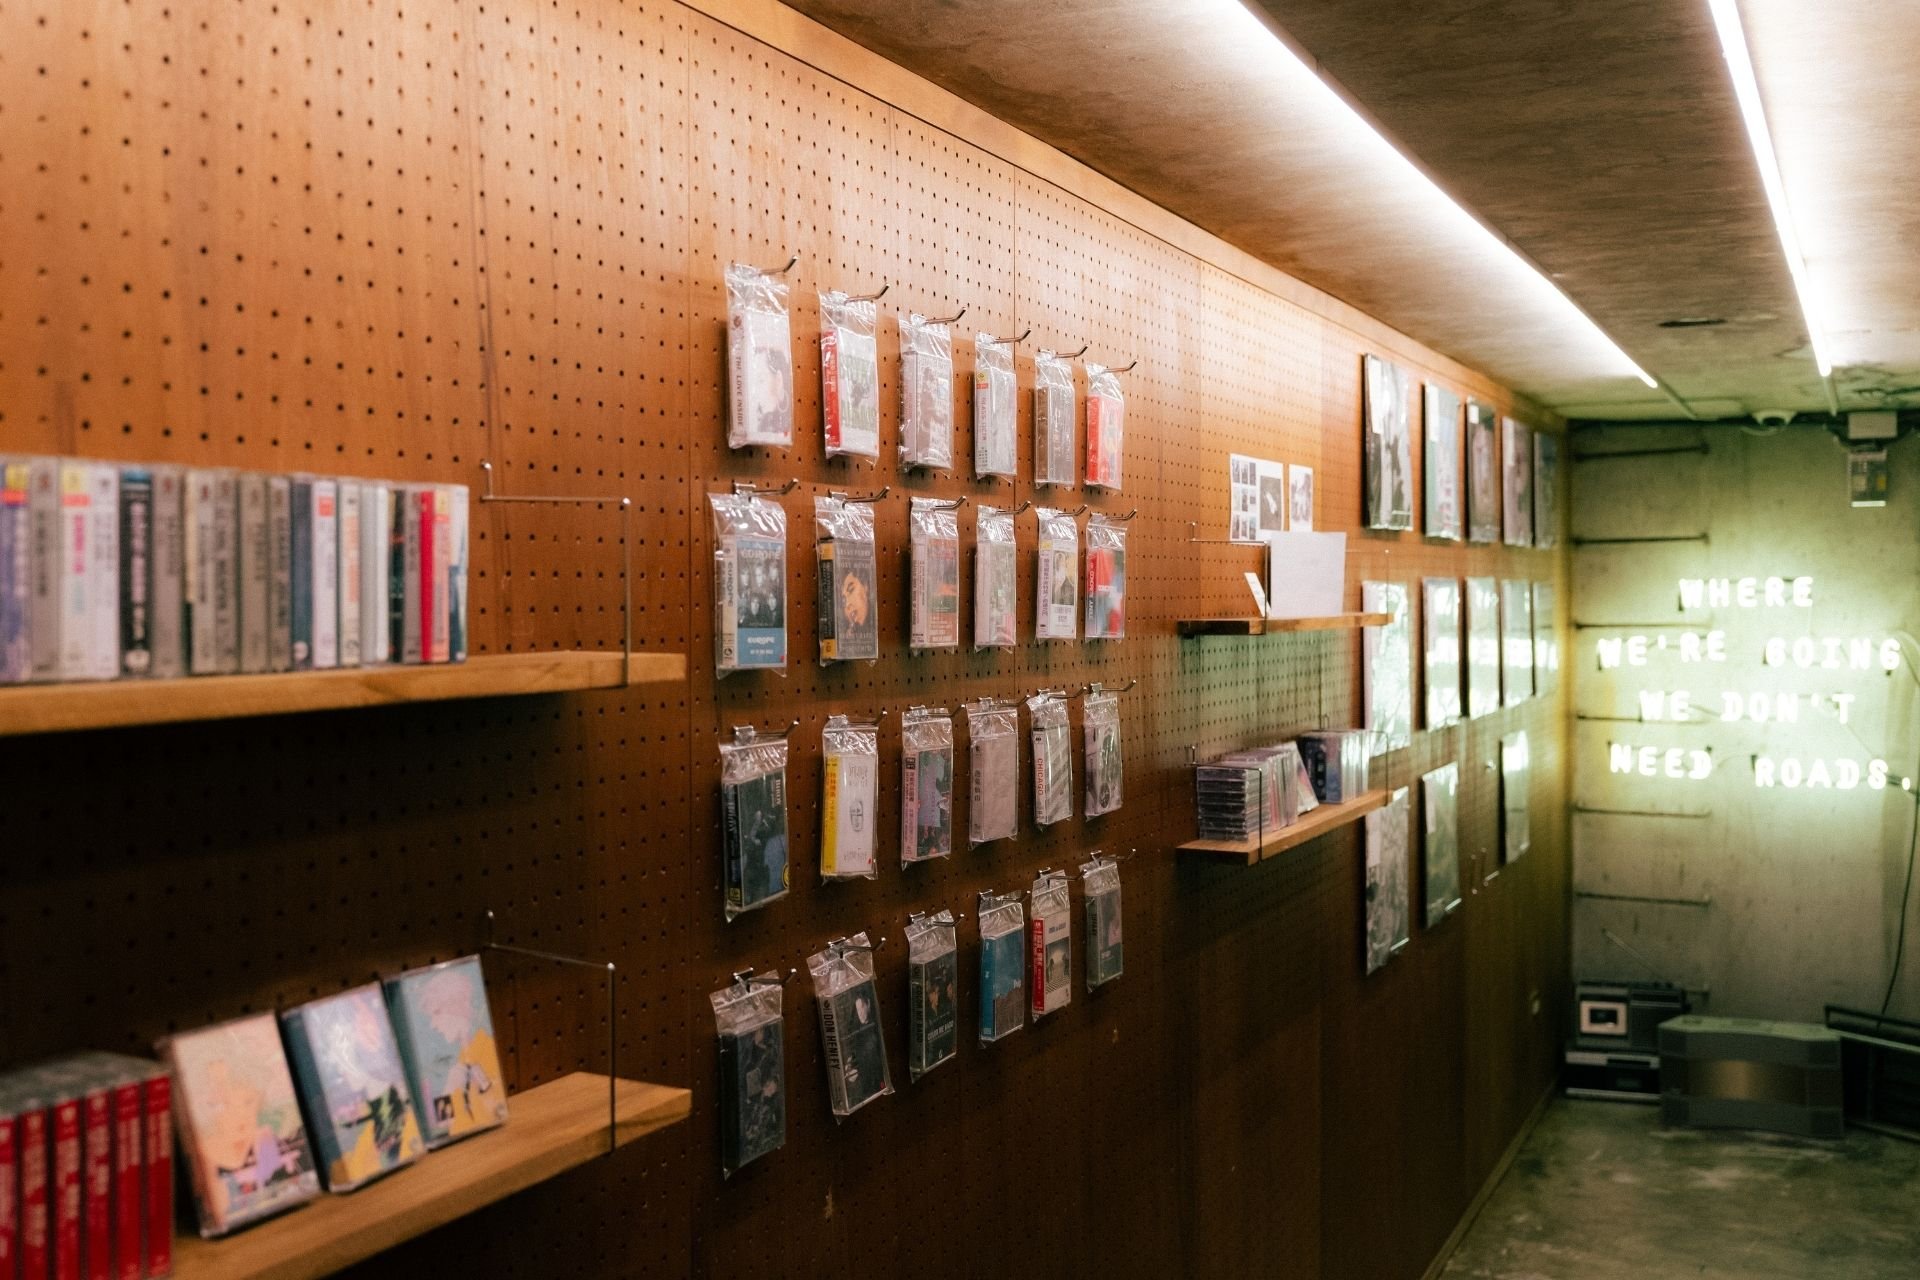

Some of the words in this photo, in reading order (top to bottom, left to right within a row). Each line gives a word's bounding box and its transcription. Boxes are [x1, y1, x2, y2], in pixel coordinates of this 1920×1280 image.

[1679, 576, 1813, 608] WHERE
[1598, 631, 1727, 668] WE'RE
[1765, 637, 1901, 670] GOING
[1639, 690, 1690, 721] WE
[1722, 691, 1855, 724] DON'T
[1610, 744, 1712, 780] NEED
[1755, 759, 1911, 790] ROADS.
[823, 1014, 835, 1033] DON
[826, 1035, 840, 1070] HENLEY
